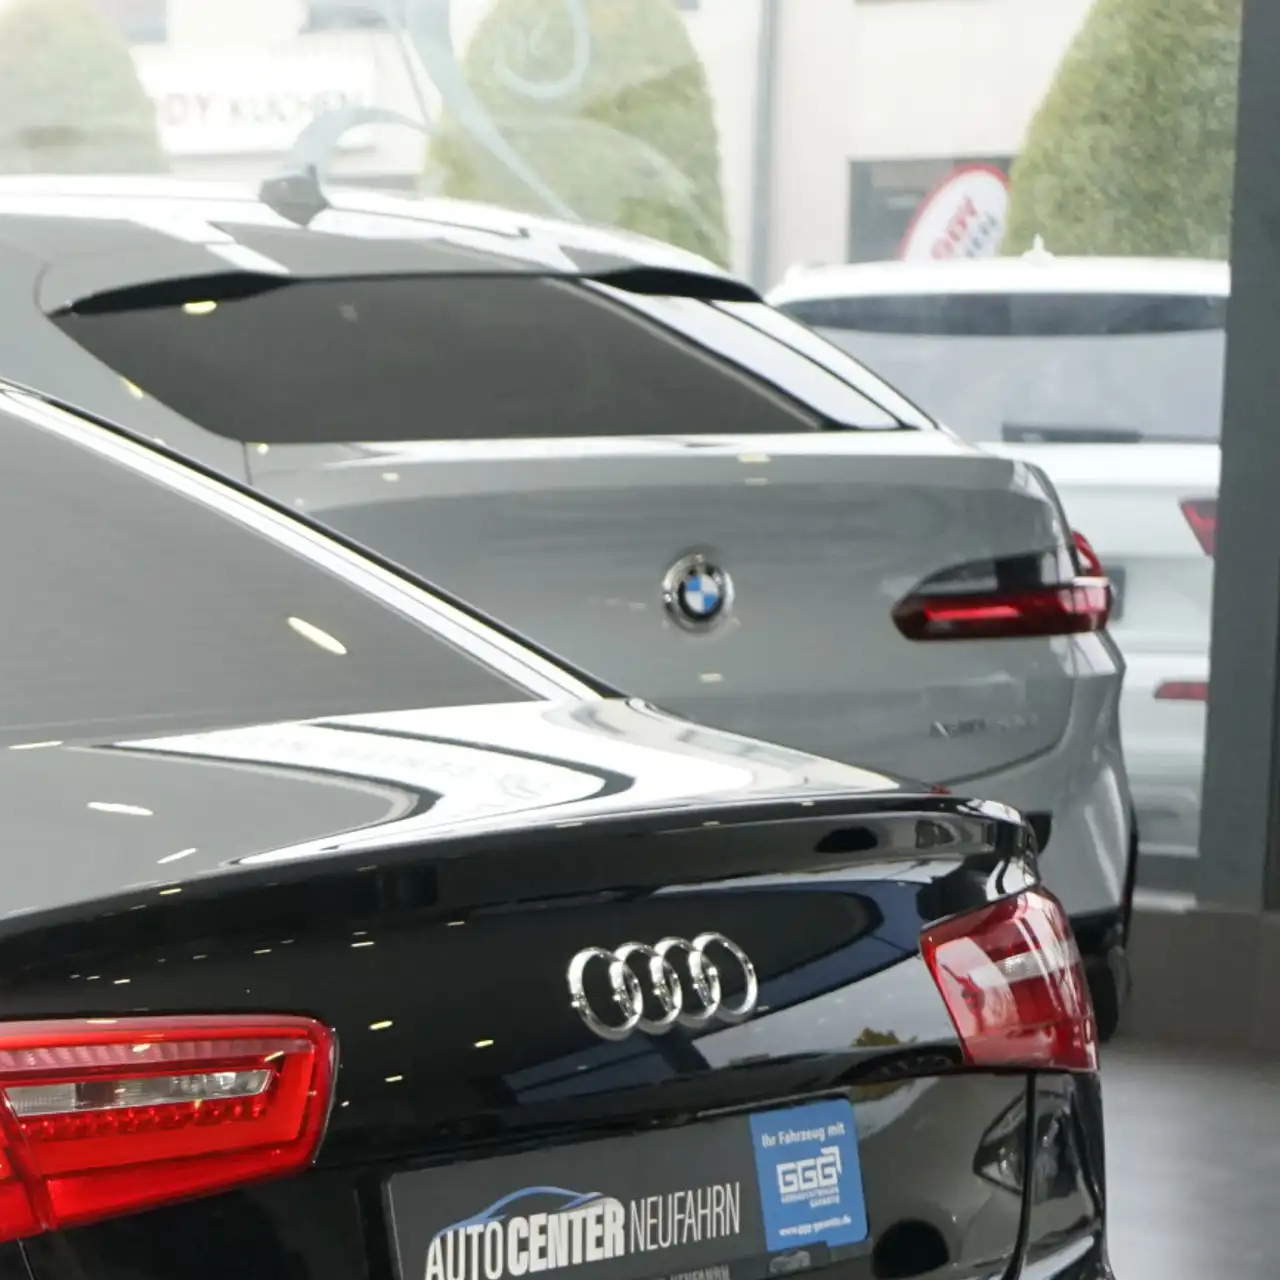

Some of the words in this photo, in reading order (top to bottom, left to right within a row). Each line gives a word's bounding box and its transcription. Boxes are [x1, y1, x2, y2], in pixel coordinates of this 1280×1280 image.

[761, 1133, 778, 1149] Ihr
[778, 1127, 827, 1145] Fahrzeug
[827, 1120, 846, 1137] mit
[629, 1181, 740, 1254] NEUFAHRN
